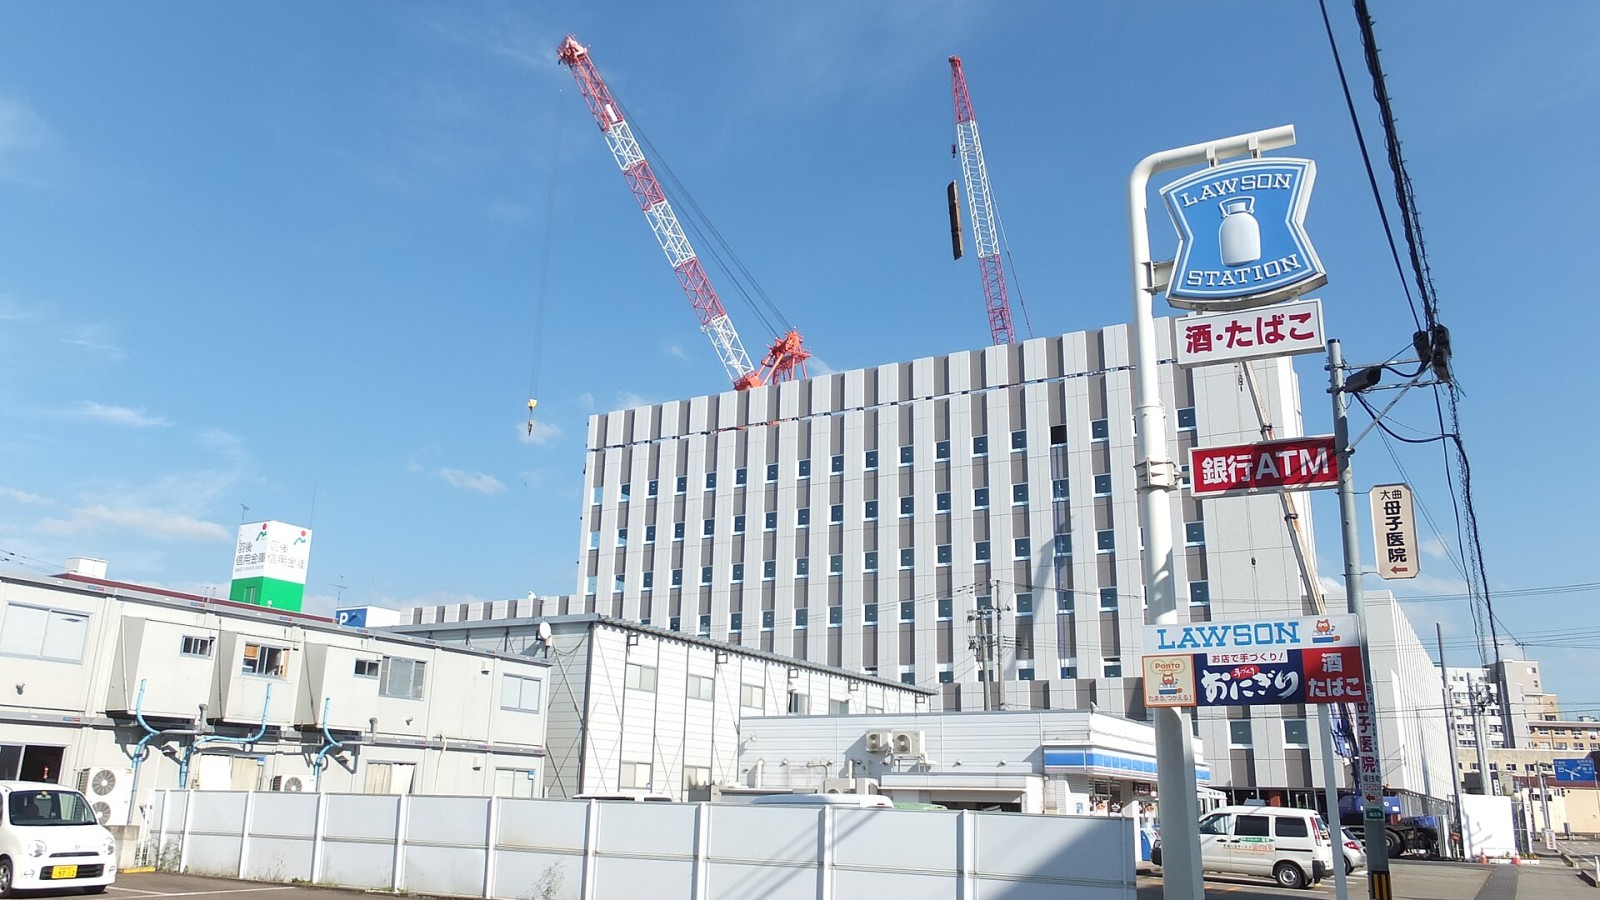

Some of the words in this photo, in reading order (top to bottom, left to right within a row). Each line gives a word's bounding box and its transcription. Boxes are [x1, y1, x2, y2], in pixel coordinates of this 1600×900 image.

[1179, 173, 1293, 208] LAWSON
[1187, 253, 1302, 287] STATION
[1185, 312, 1315, 354] 酒・たばこ
[1201, 446, 1329, 486] 銀行ATM
[1380, 489, 1403, 501] 大曲
[1383, 500, 1407, 563] 母子医院
[1157, 621, 1301, 650] LAWSON
[1321, 652, 1343, 673] 酒
[1201, 669, 1300, 703] おにぎり
[1308, 677, 1362, 698] たばこ
